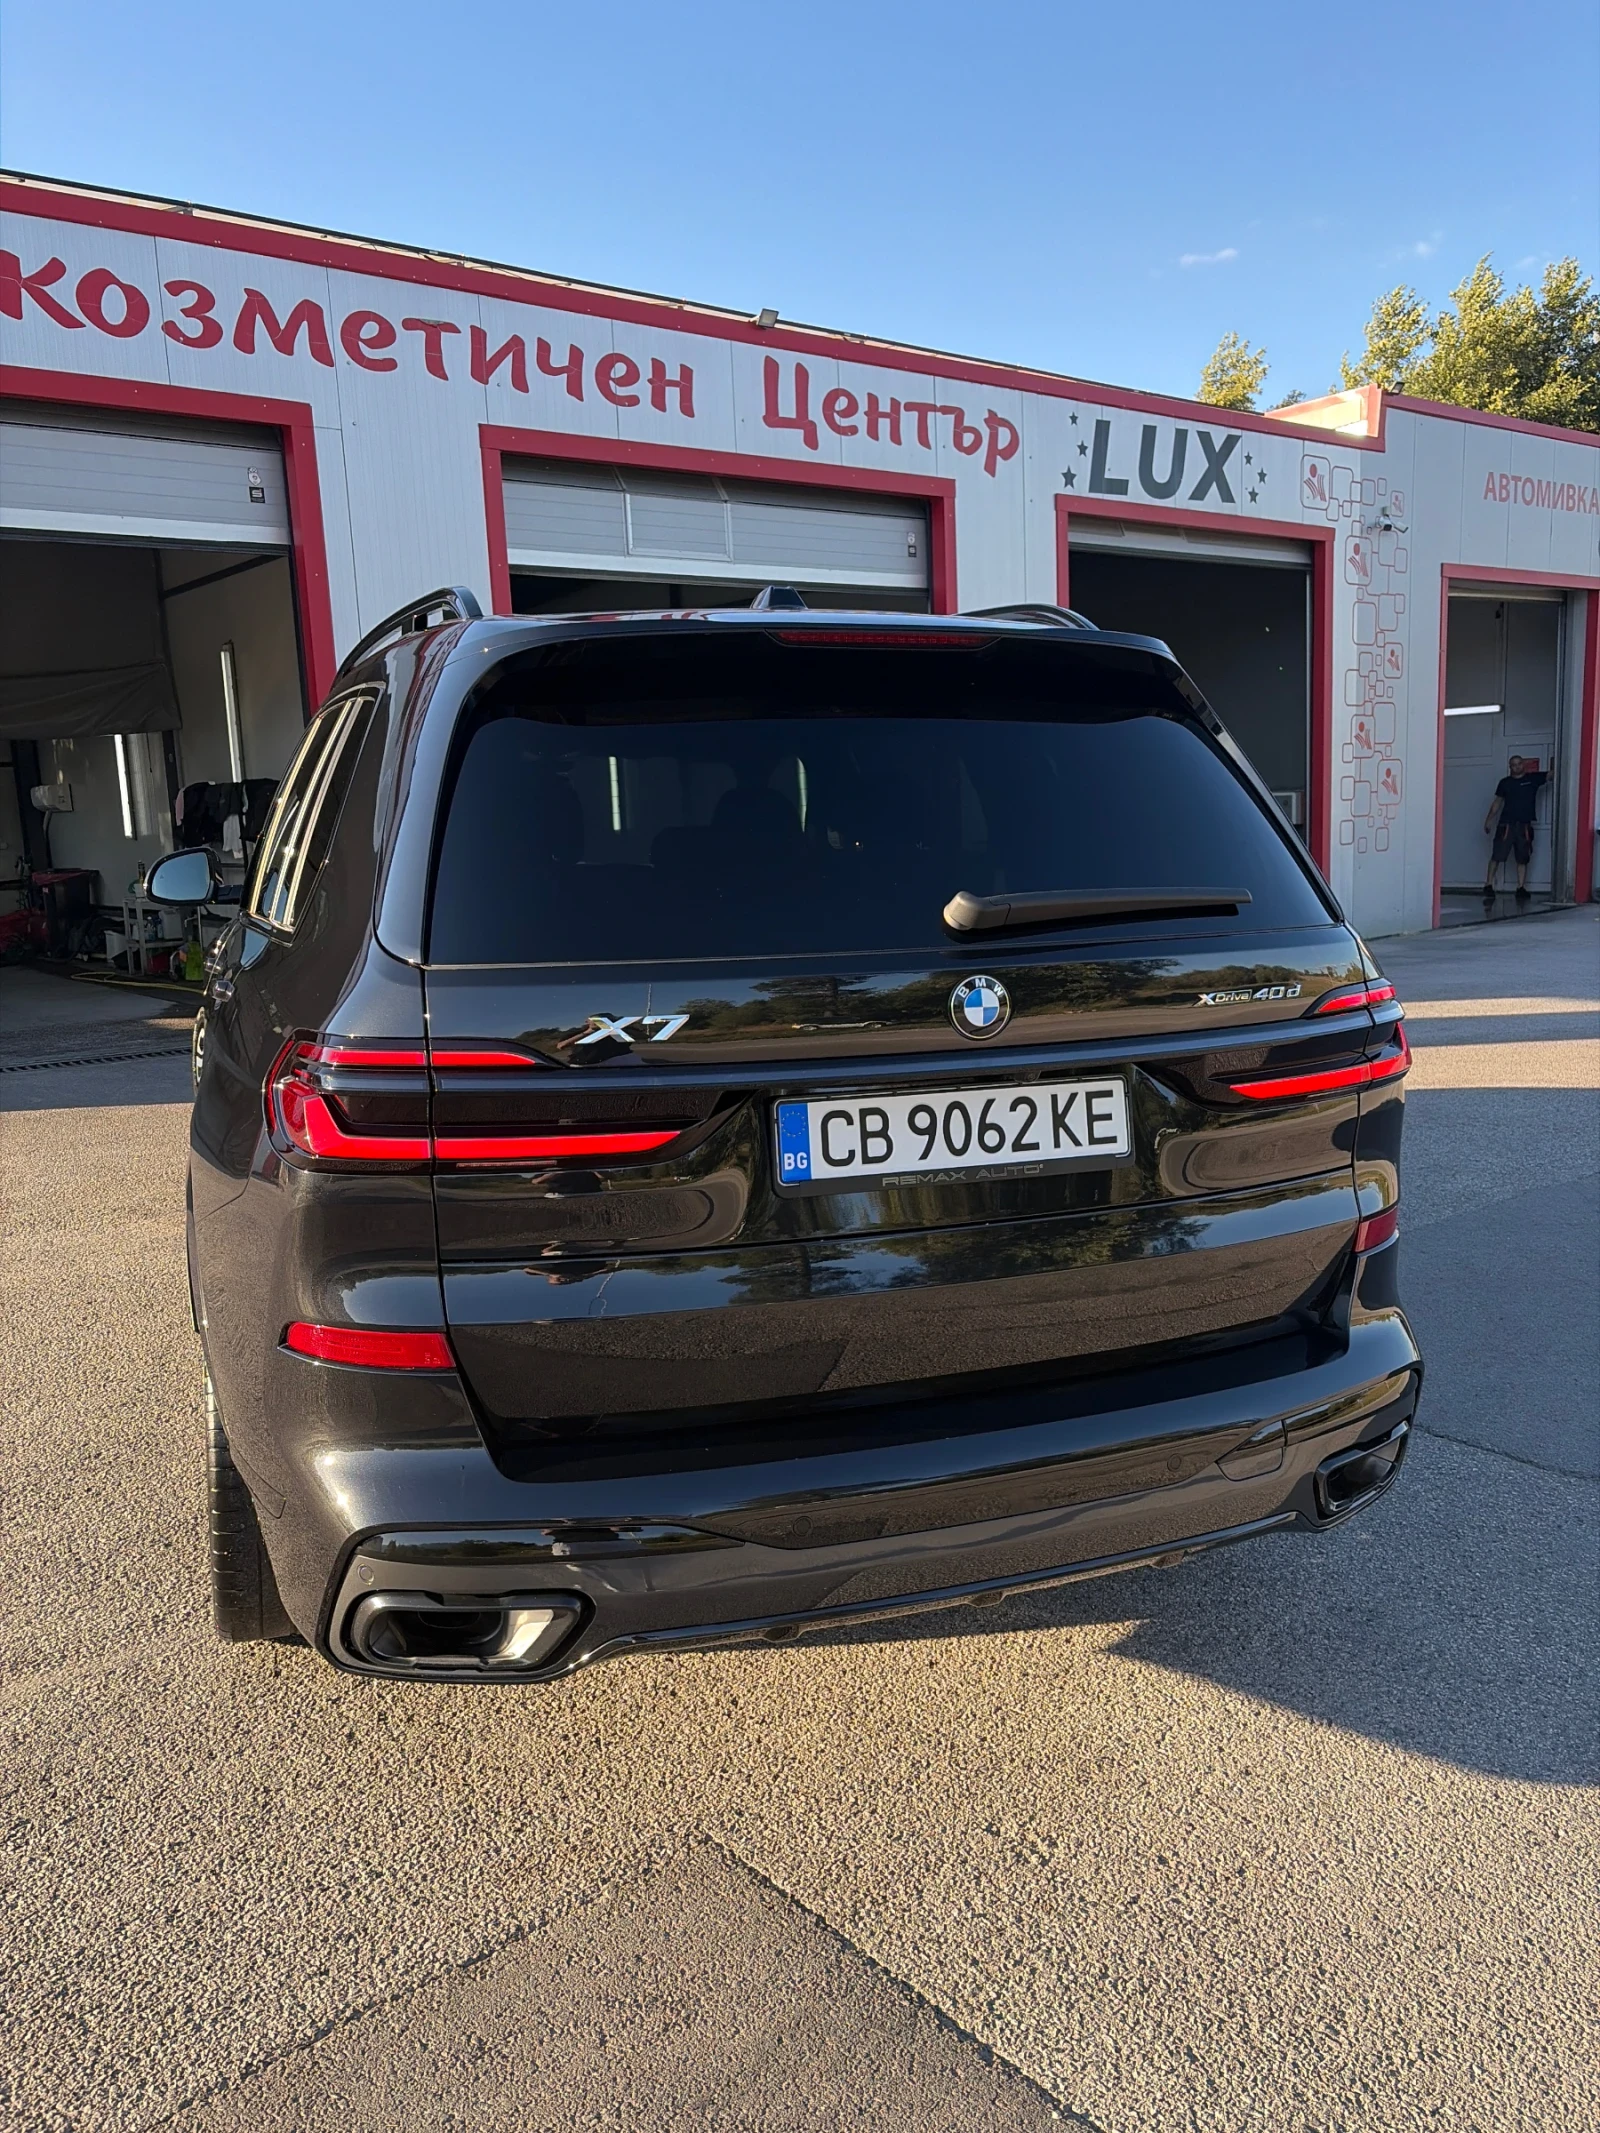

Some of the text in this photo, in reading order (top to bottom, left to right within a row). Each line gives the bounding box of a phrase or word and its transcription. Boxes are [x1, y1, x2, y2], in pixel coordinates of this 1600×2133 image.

[762, 355, 1020, 478] Център
[1088, 418, 1242, 504] LUX
[1483, 471, 1600, 516] АВТОМИВКА
[957, 978, 1004, 998] BMW
[574, 1014, 690, 1045] X7
[907, 1096, 1040, 1161] 9062
[783, 1152, 808, 1170] BG
[882, 1165, 1040, 1187] REMAX AUTO
